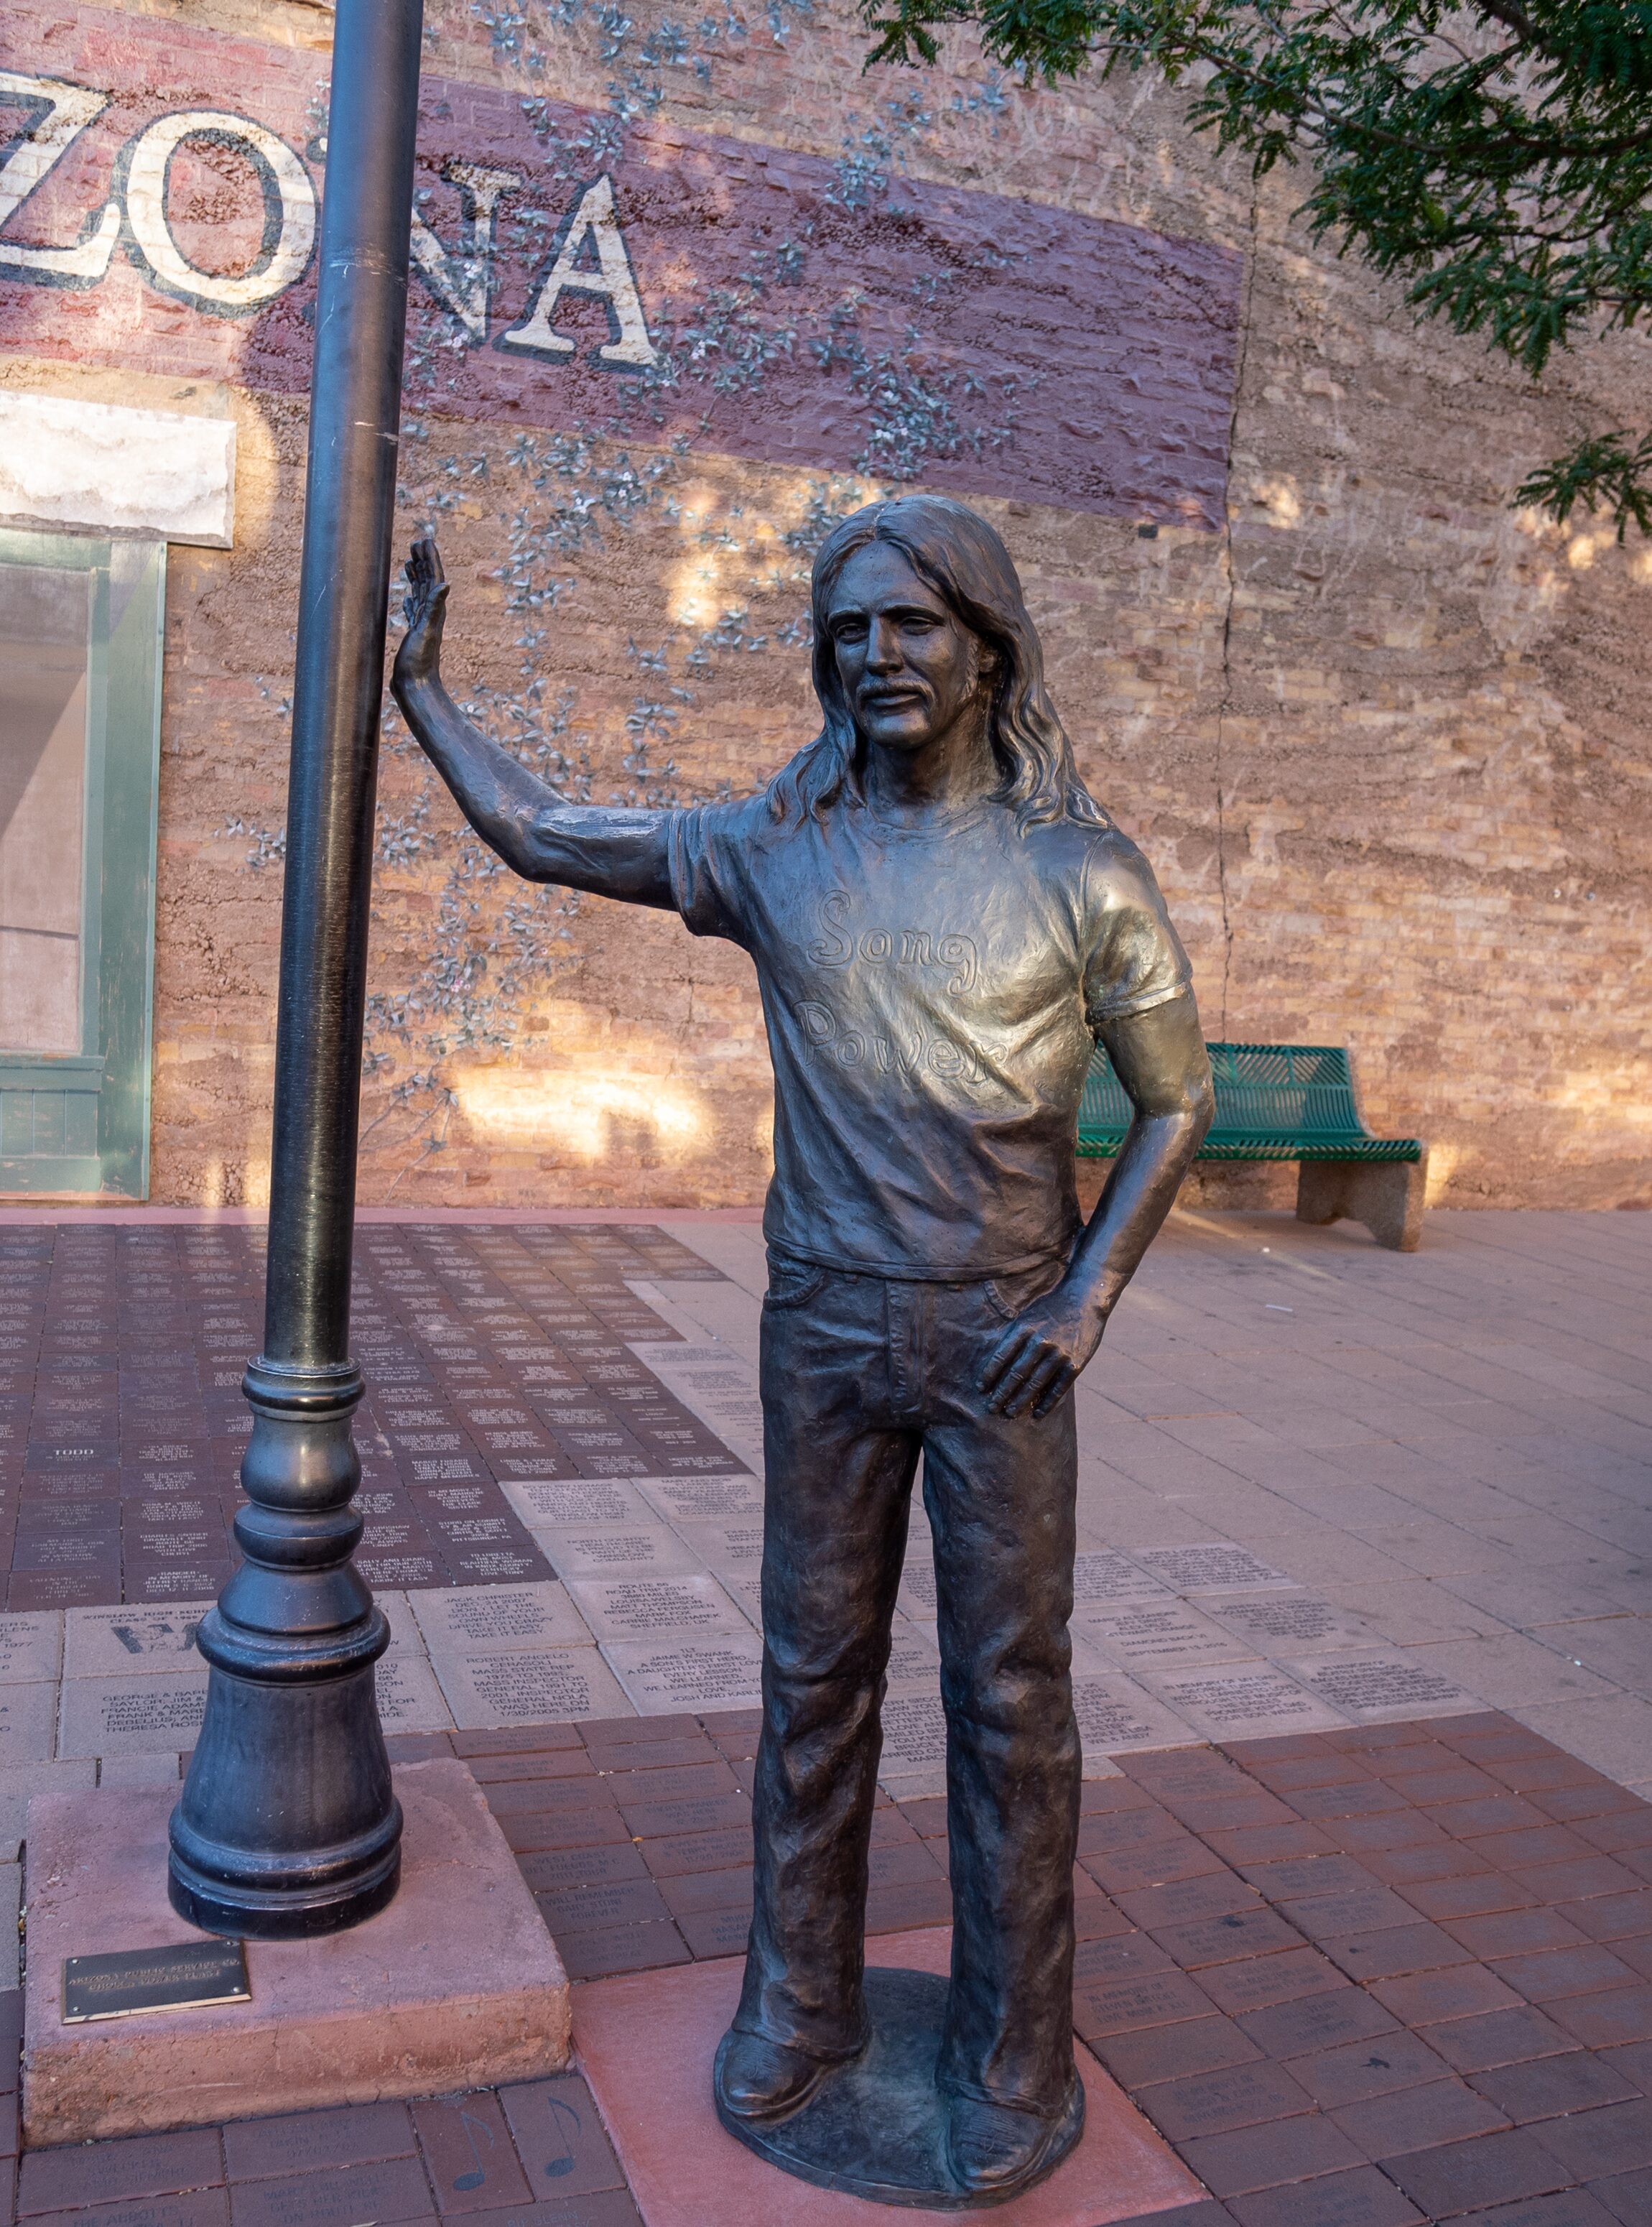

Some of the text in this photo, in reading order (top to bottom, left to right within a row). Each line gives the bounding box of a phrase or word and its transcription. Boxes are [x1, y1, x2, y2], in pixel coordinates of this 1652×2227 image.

[807, 889, 978, 998] Song
[794, 999, 1008, 1086] Power
[477, 1592, 534, 1601] CHRISTER
[643, 1599, 703, 1608] THOMPSON
[491, 1613, 539, 1621] WHEELS
[1123, 1611, 1179, 1621] ALEXANDRE
[1107, 1624, 1197, 1637] STEWART ORANGE
[1120, 1637, 1167, 1647] DIAMOND
[1125, 1646, 1187, 1657] SEPTEMBER
[514, 1676, 585, 1685] INSPECTOR
[664, 1682, 713, 1690] LEARNED
[517, 1687, 590, 1697] INSPECTOR
[103, 1693, 157, 1702] GEORGE
[101, 1706, 159, 1715] FRANCIE
[106, 1723, 167, 1733] THERESA
[545, 1897, 570, 1907] WILL
[124, 1966, 166, 1978] PUBLIC
[171, 1961, 218, 1973] SERVICE
